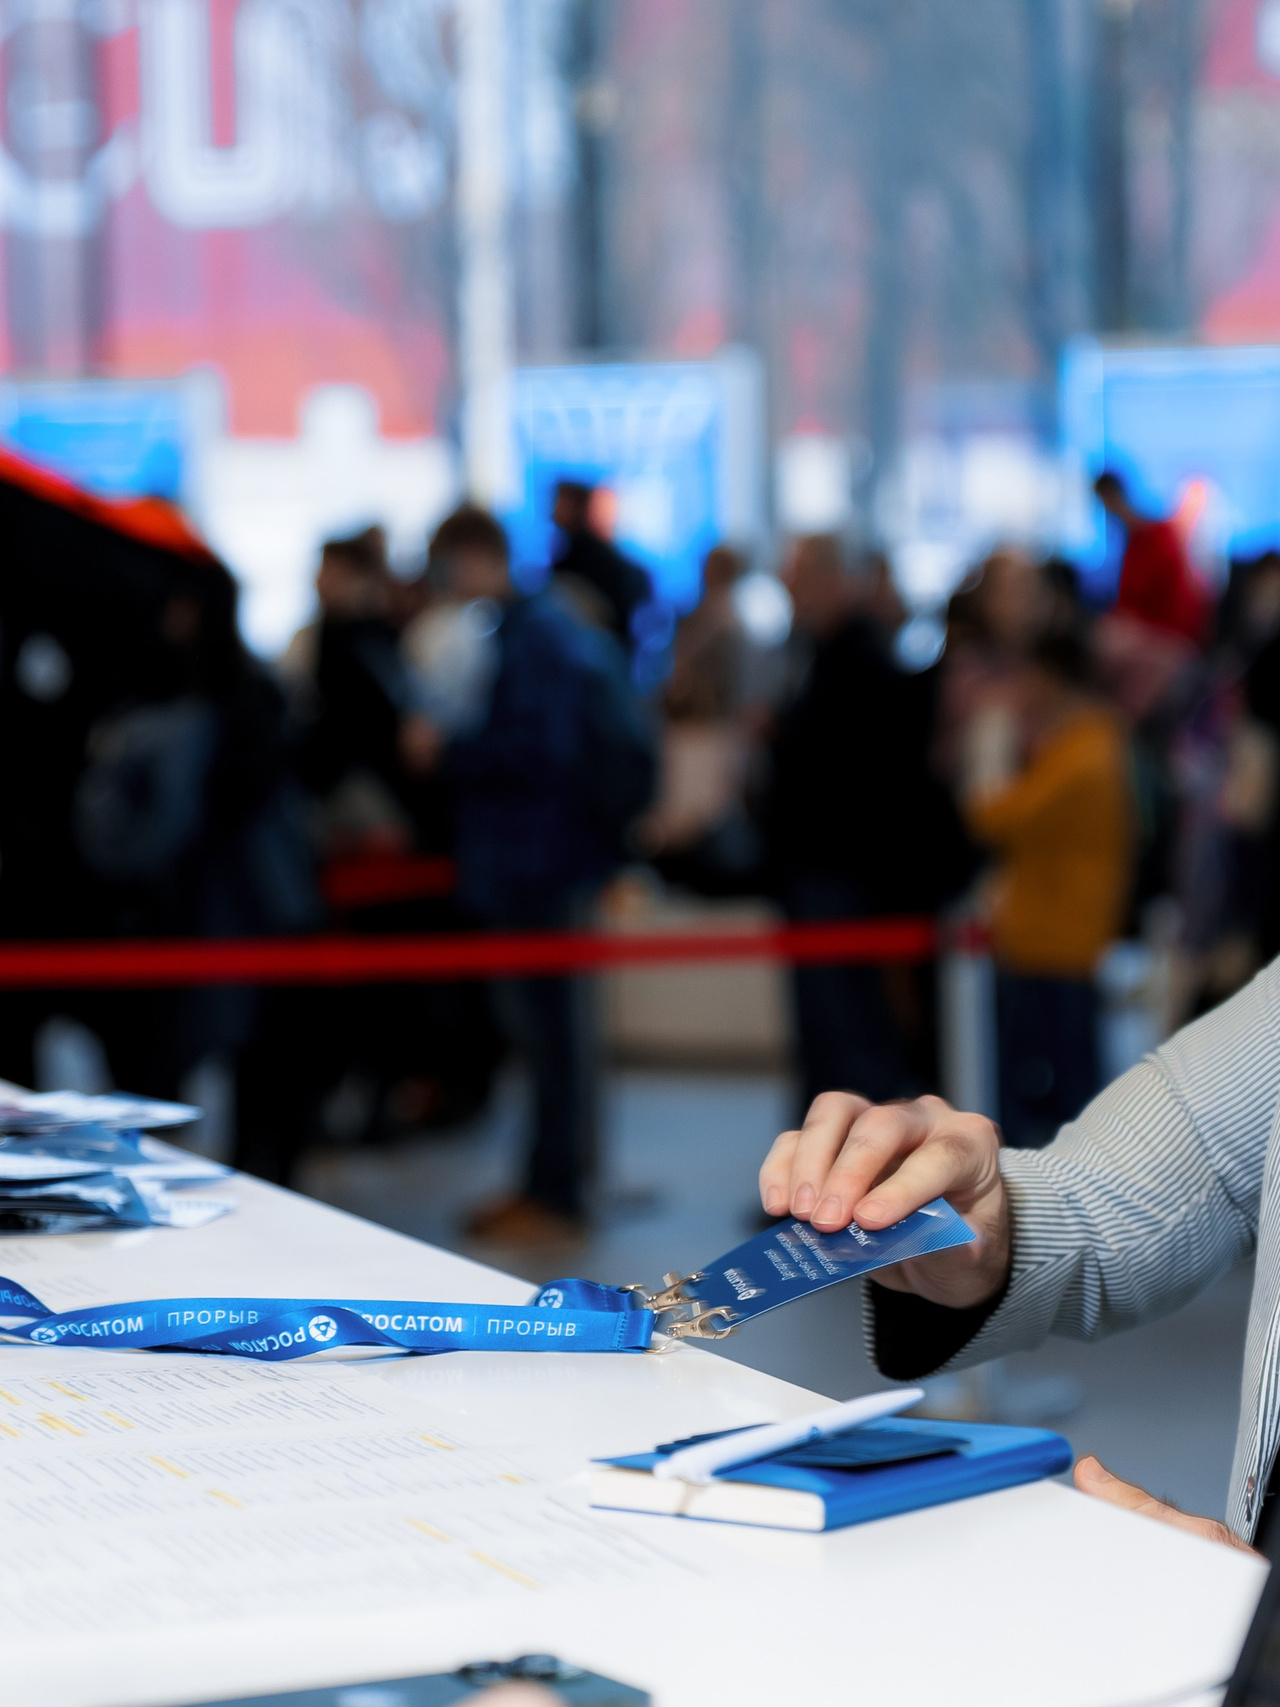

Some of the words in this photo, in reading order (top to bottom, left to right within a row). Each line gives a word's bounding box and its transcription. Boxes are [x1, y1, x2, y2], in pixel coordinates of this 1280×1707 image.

[764, 1249, 797, 1281] Департамент
[723, 1268, 749, 1294] РОСАТОМ
[56, 1316, 144, 1337] РОСАТОМ
[167, 1310, 259, 1328] ПРОРЫВ
[487, 1319, 577, 1337] ПРОРЫВ
[228, 1326, 307, 1353] РОСАТОМ
